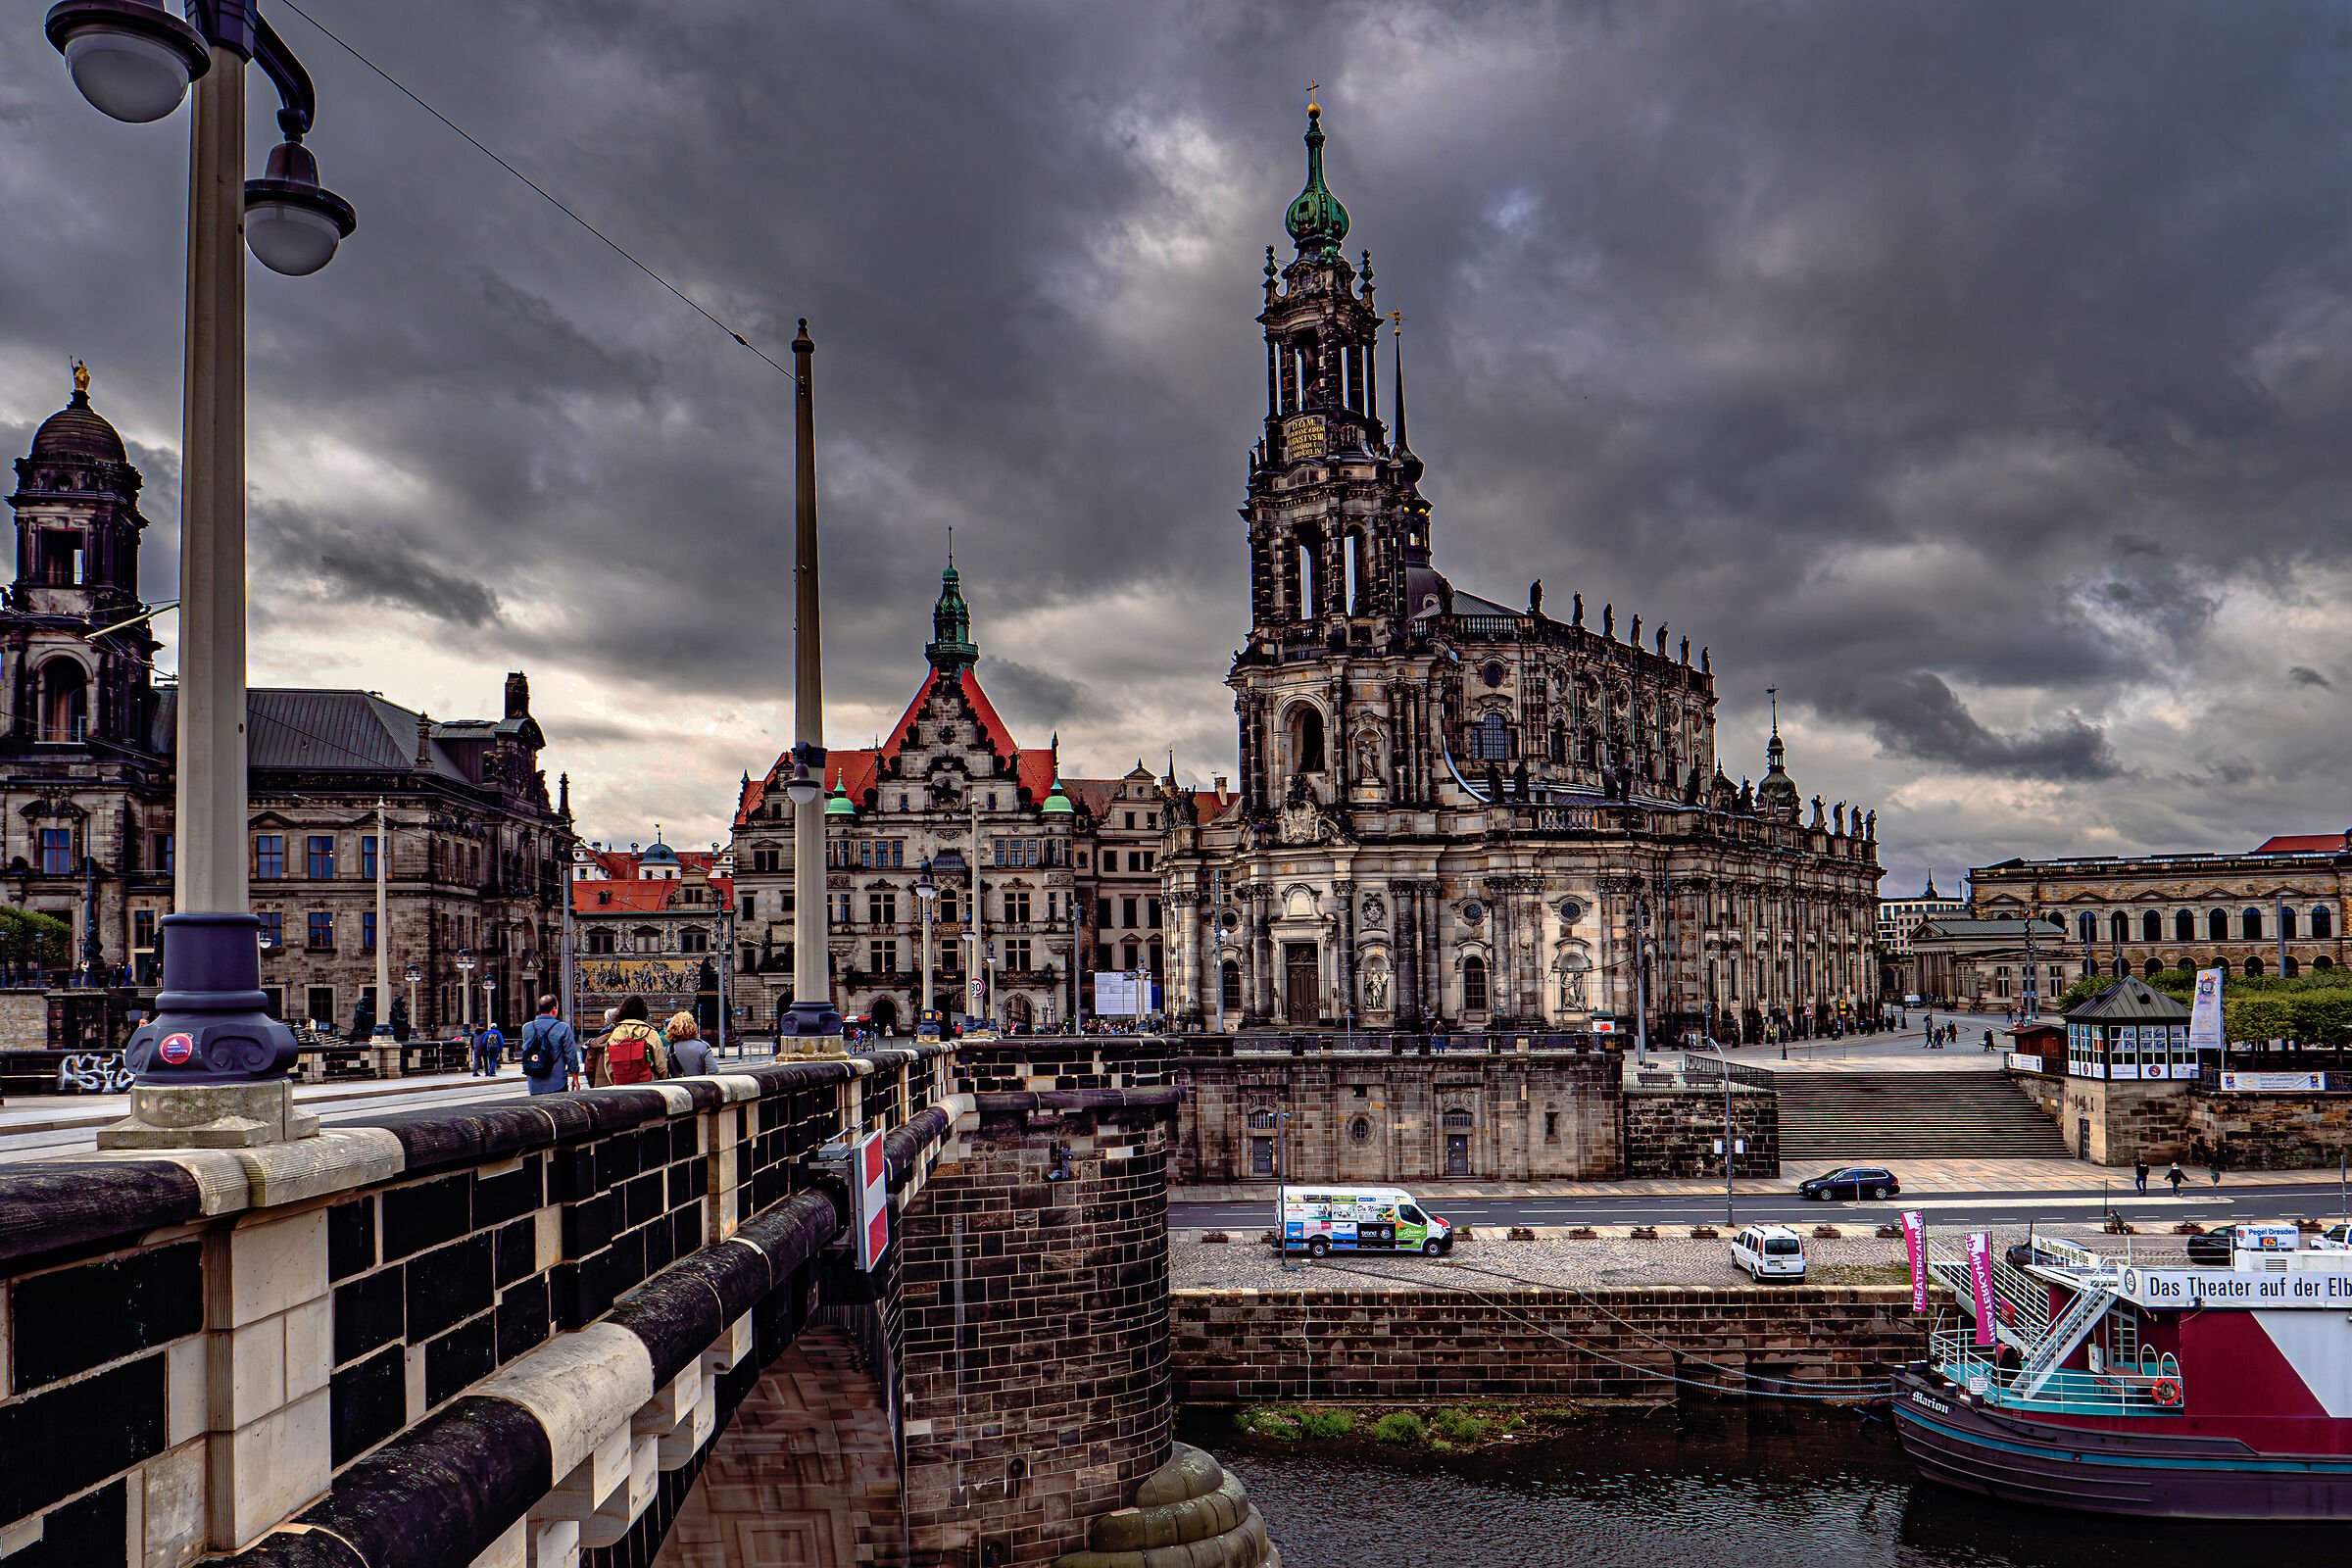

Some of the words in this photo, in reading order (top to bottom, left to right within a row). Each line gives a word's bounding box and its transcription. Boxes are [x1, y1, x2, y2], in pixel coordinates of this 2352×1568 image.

[2262, 1237, 2277, 1247] 105
[1913, 1209, 1924, 1310] THEATERKAHN.de
[2149, 1277, 2180, 1297] Das
[2187, 1277, 2252, 1297] Theater
[2259, 1277, 2286, 1297] auf
[2293, 1277, 2322, 1297] der
[1911, 1391, 1950, 1414] Marion
